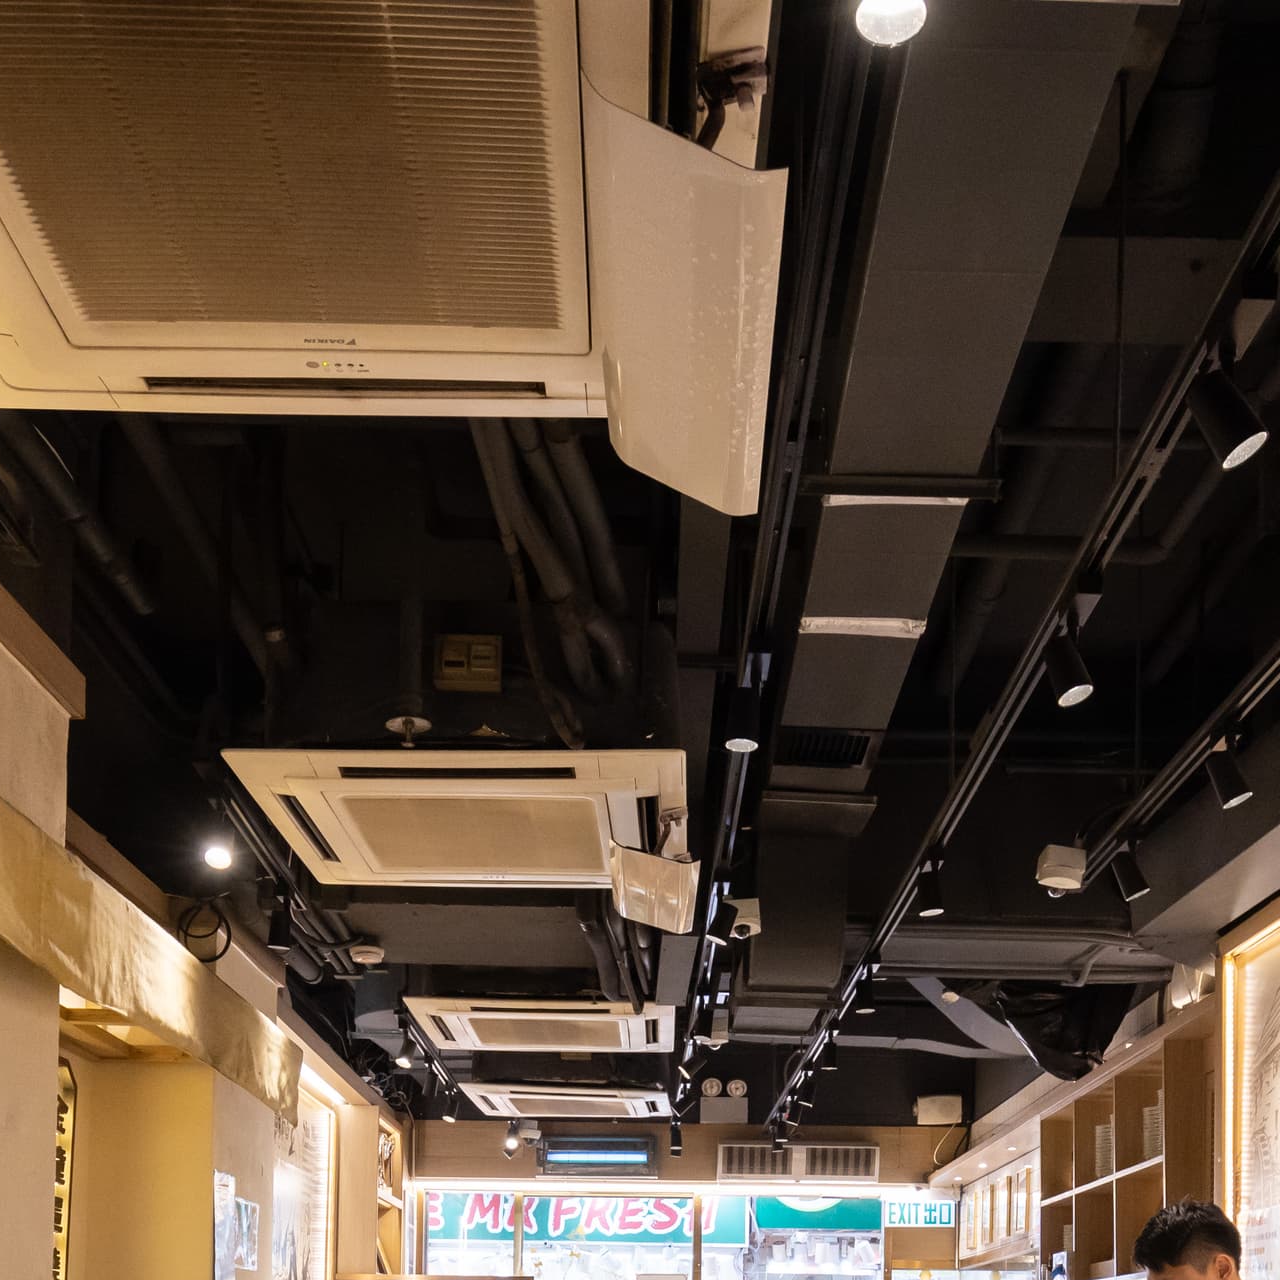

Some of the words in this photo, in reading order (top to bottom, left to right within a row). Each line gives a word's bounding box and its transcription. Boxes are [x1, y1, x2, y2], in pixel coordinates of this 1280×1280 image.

[552, 1195, 716, 1234] FRESH
[888, 1202, 919, 1225] EXIT
[923, 1202, 952, 1225] 出口
